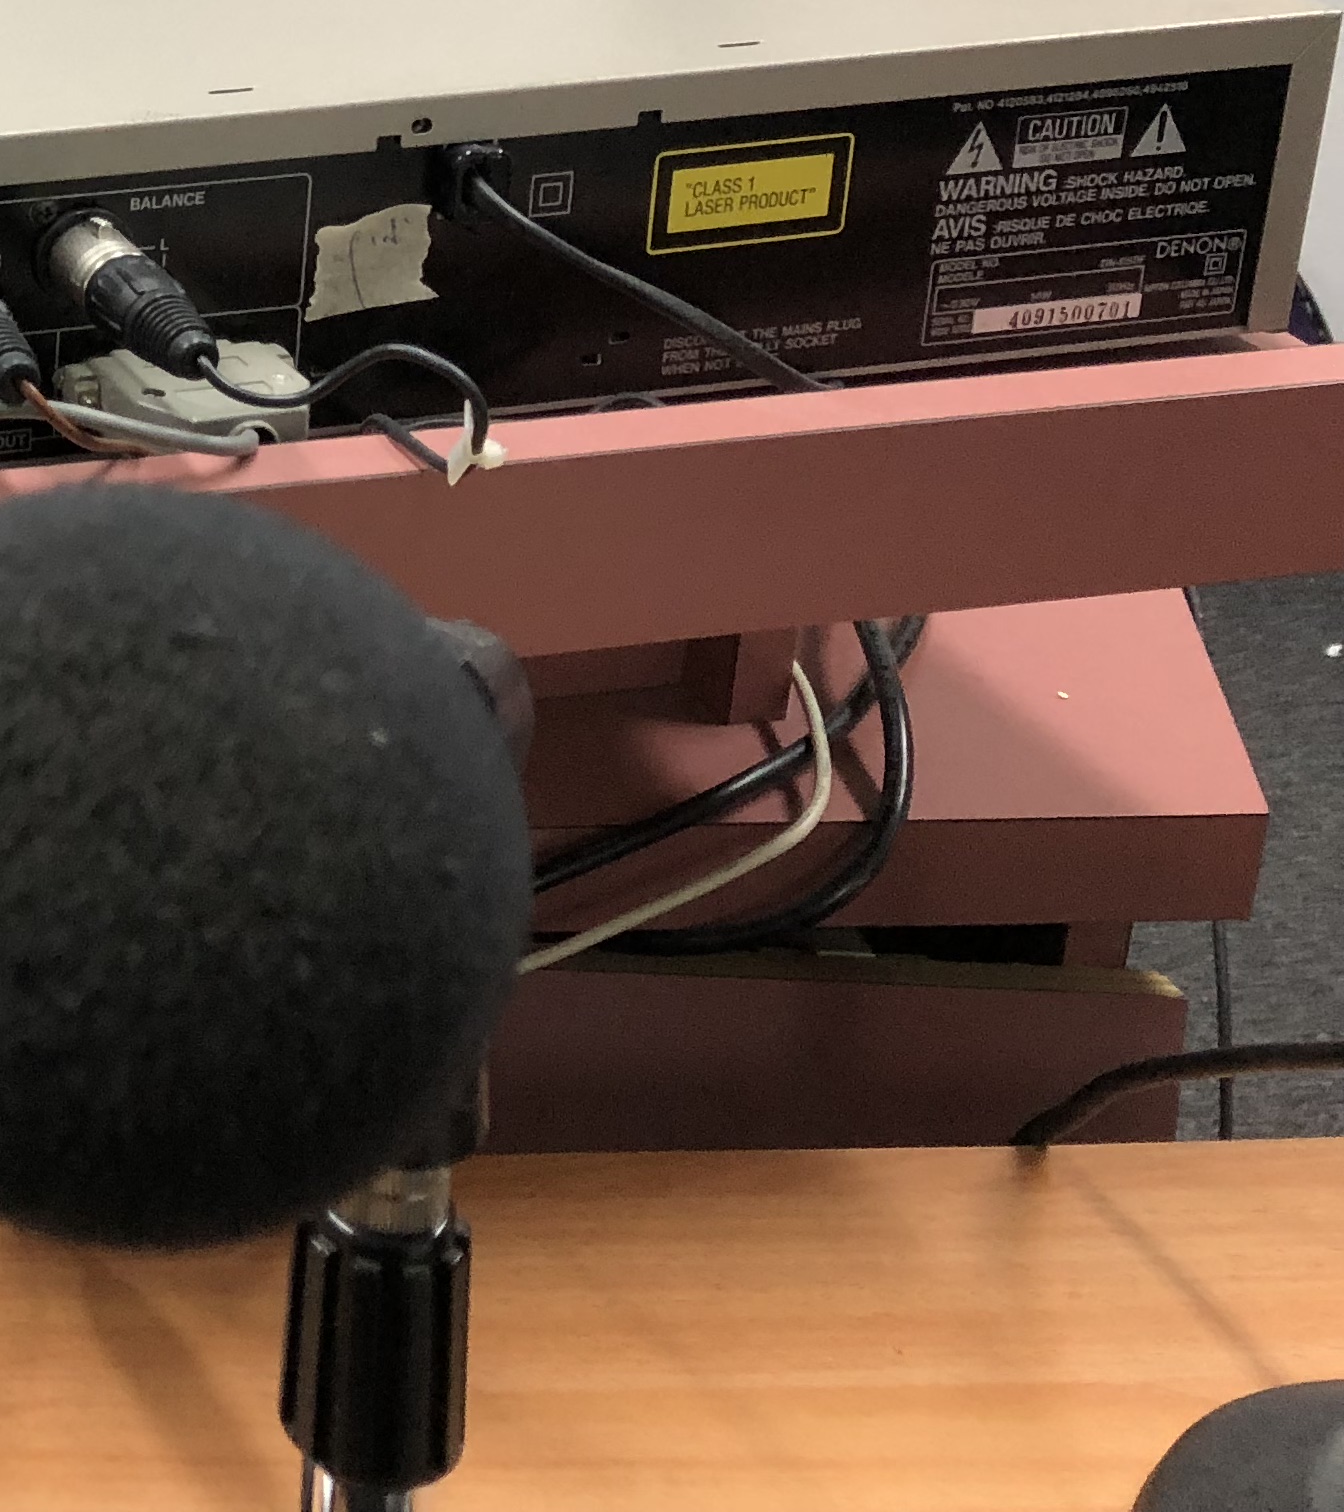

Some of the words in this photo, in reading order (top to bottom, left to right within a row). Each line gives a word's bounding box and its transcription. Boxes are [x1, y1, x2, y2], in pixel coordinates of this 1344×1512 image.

[1028, 112, 1117, 140] CAUTION
[934, 196, 1028, 217] DANGEROUS
[1032, 188, 1098, 207] VOLTAGE
[1180, 177, 1211, 193] NOT
[938, 169, 1058, 201] WARNING
[129, 191, 206, 212] BALANCE
[684, 196, 734, 217] LASER
[931, 214, 987, 240] AVIS
